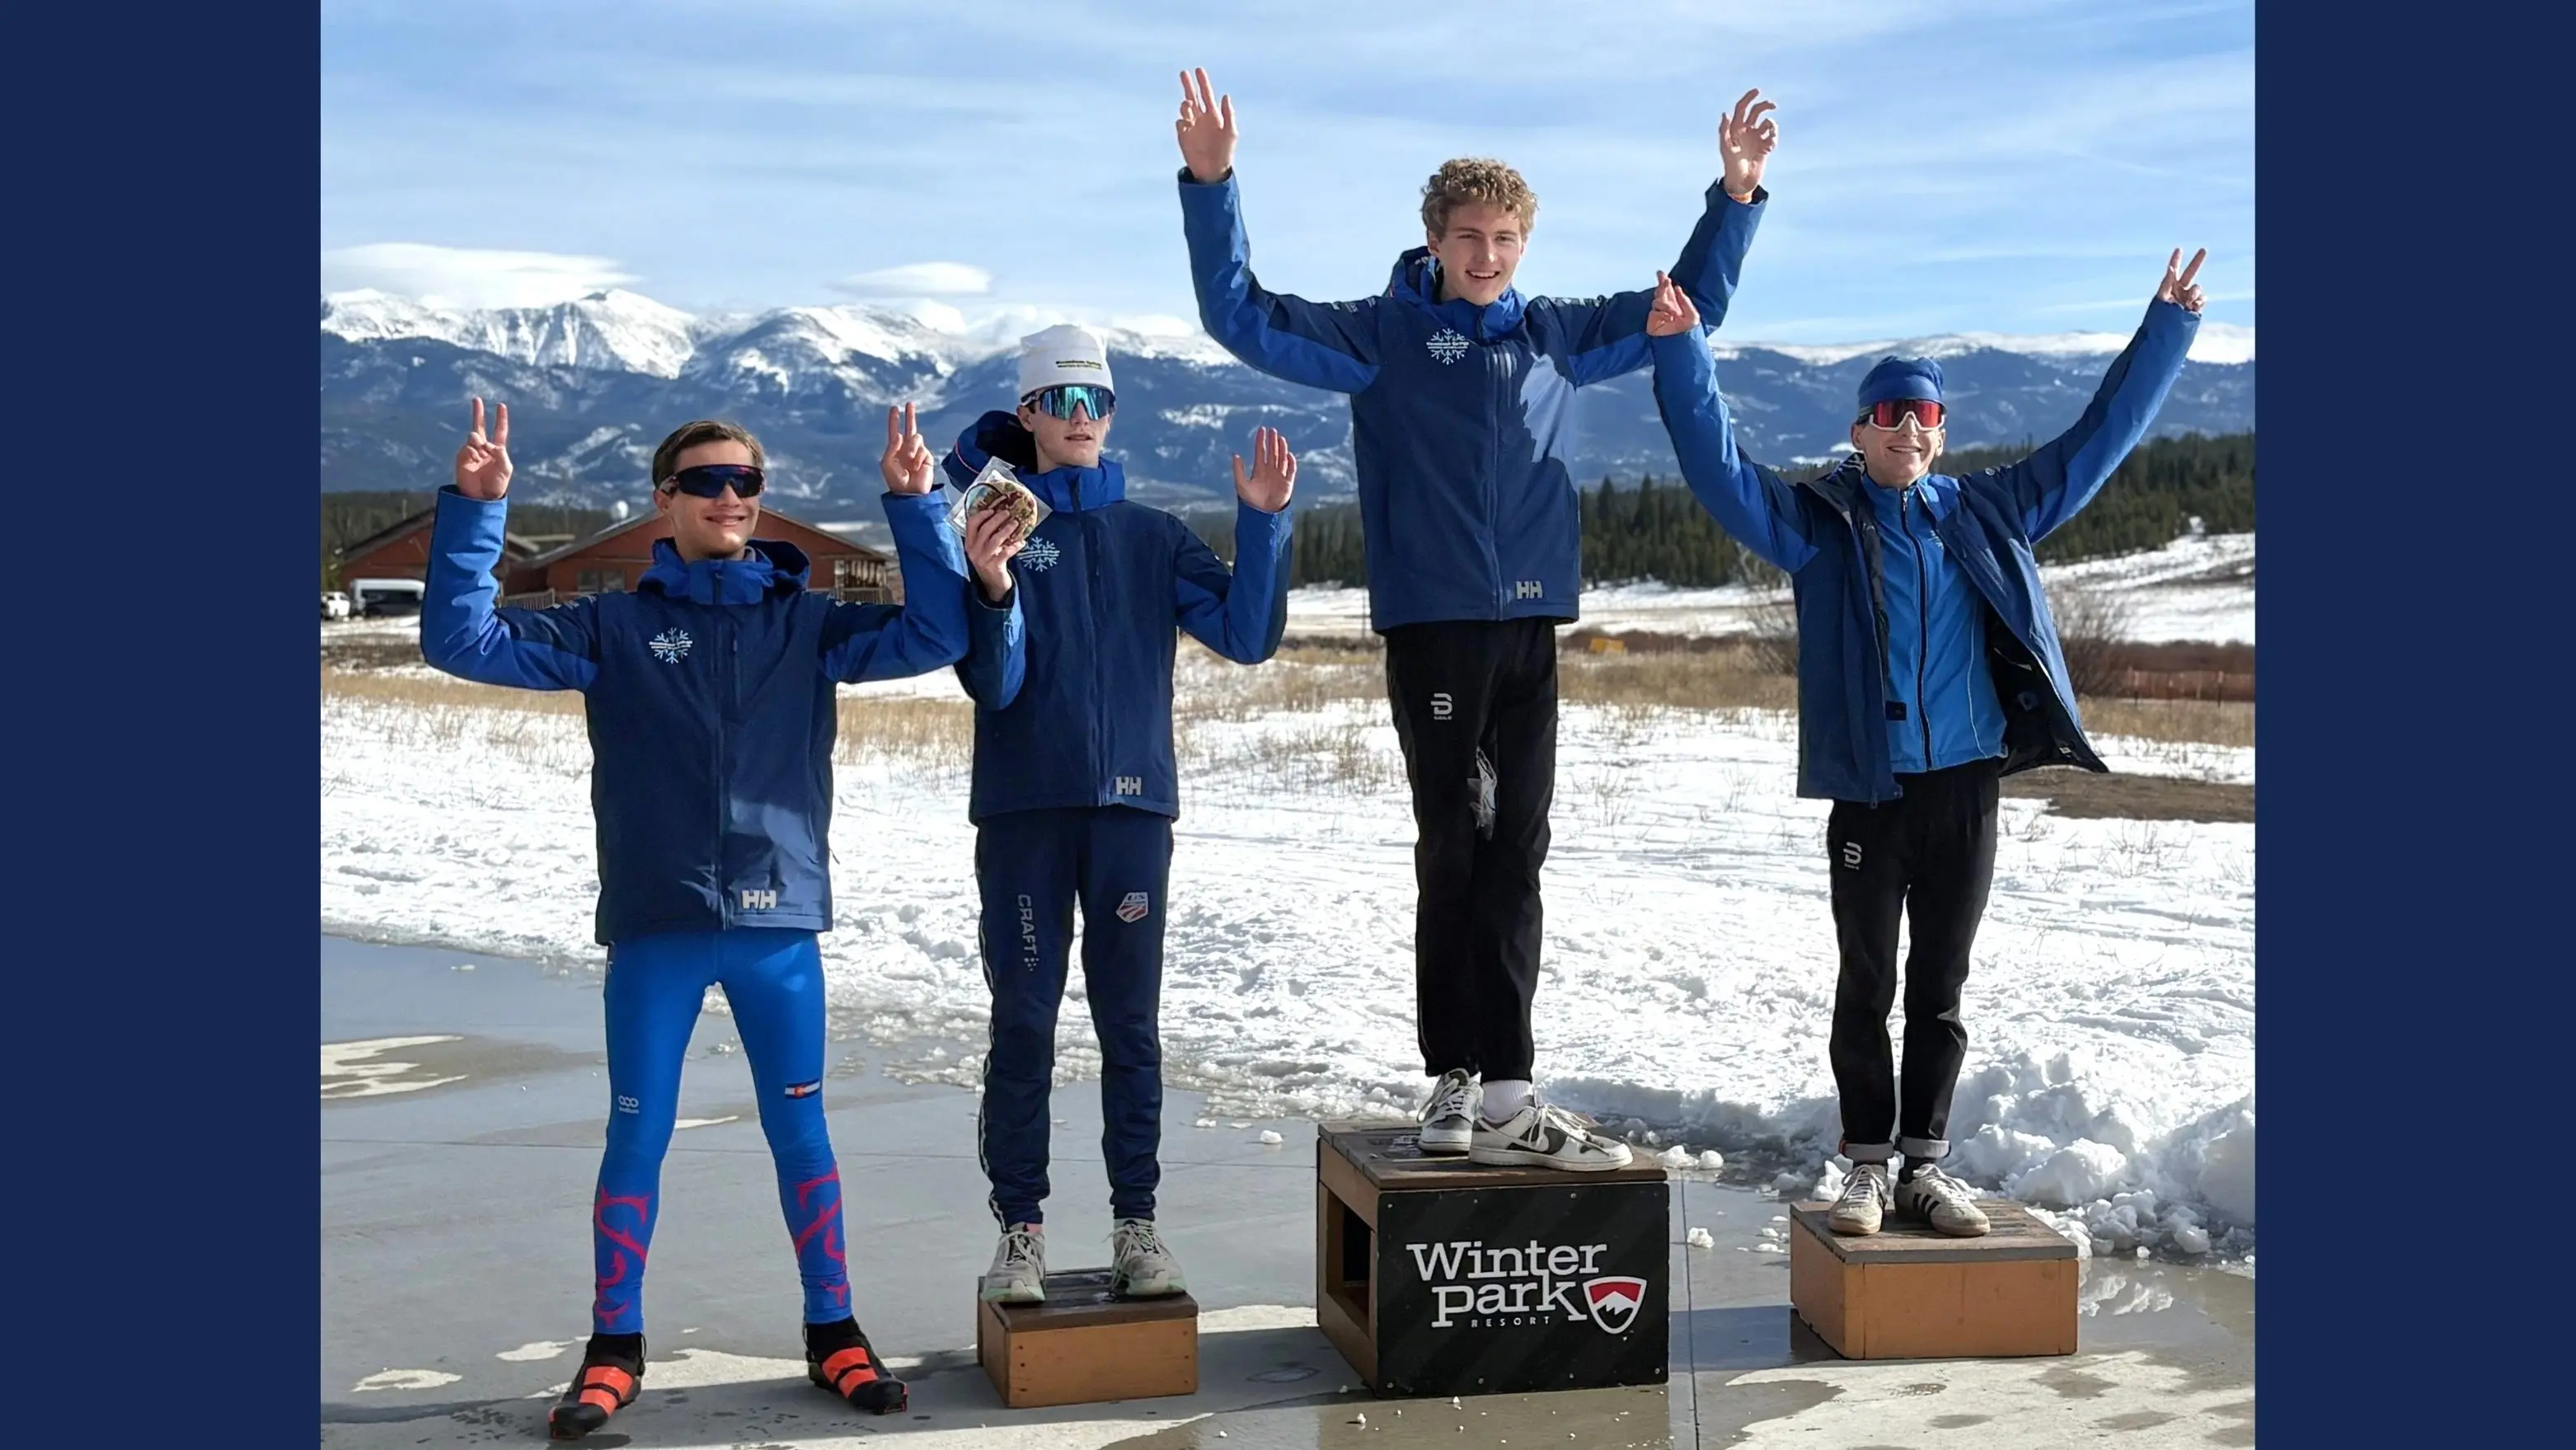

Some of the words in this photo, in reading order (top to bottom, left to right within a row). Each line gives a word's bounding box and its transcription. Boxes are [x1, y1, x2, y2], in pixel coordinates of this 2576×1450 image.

[1516, 580, 1542, 599] HH
[1115, 777, 1142, 795] HH
[742, 889, 777, 909] HH
[1017, 894, 1038, 955] CRAFT
[1405, 1240, 1607, 1281] Winter
[1471, 1316, 1551, 1328] RESORT
